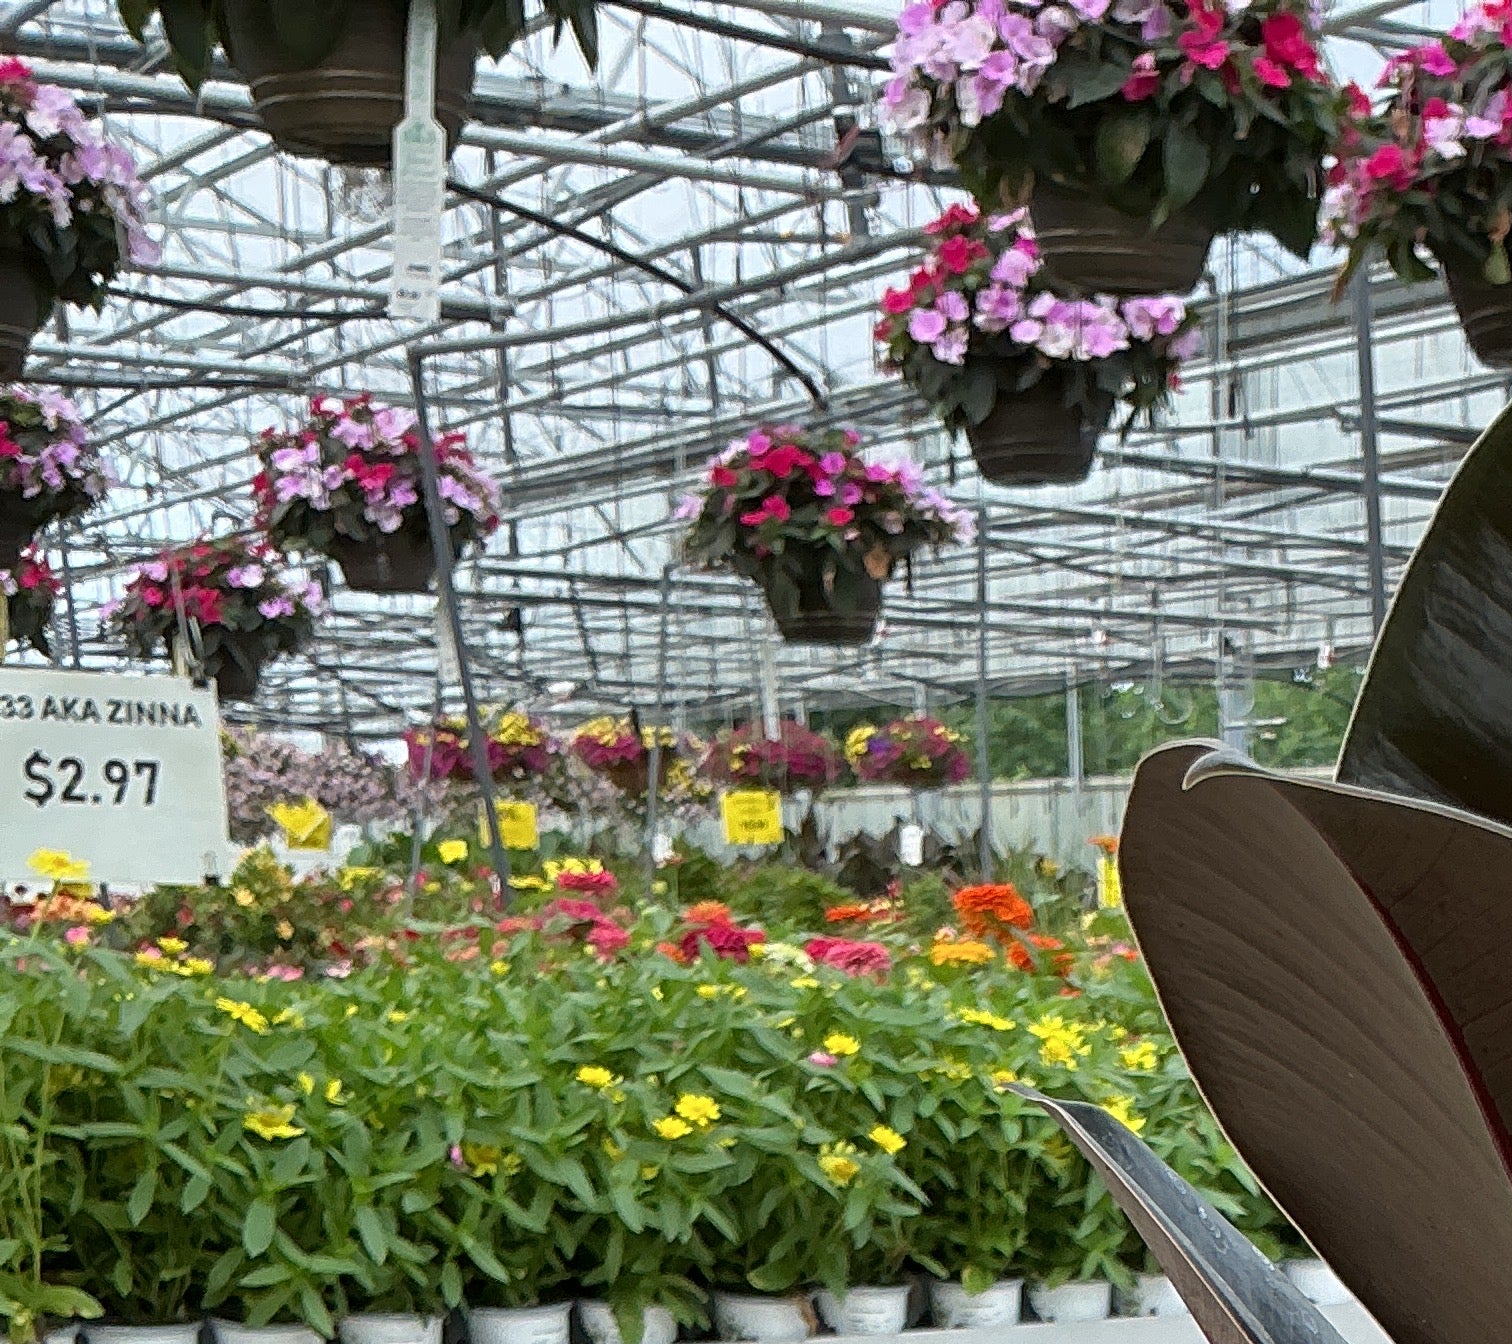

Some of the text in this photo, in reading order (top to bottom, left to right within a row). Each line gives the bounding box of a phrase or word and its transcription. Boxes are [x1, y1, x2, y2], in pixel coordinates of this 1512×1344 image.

[40, 695, 101, 723] AKA
[106, 699, 202, 729] ZINNA
[24, 750, 160, 808] $2.97
